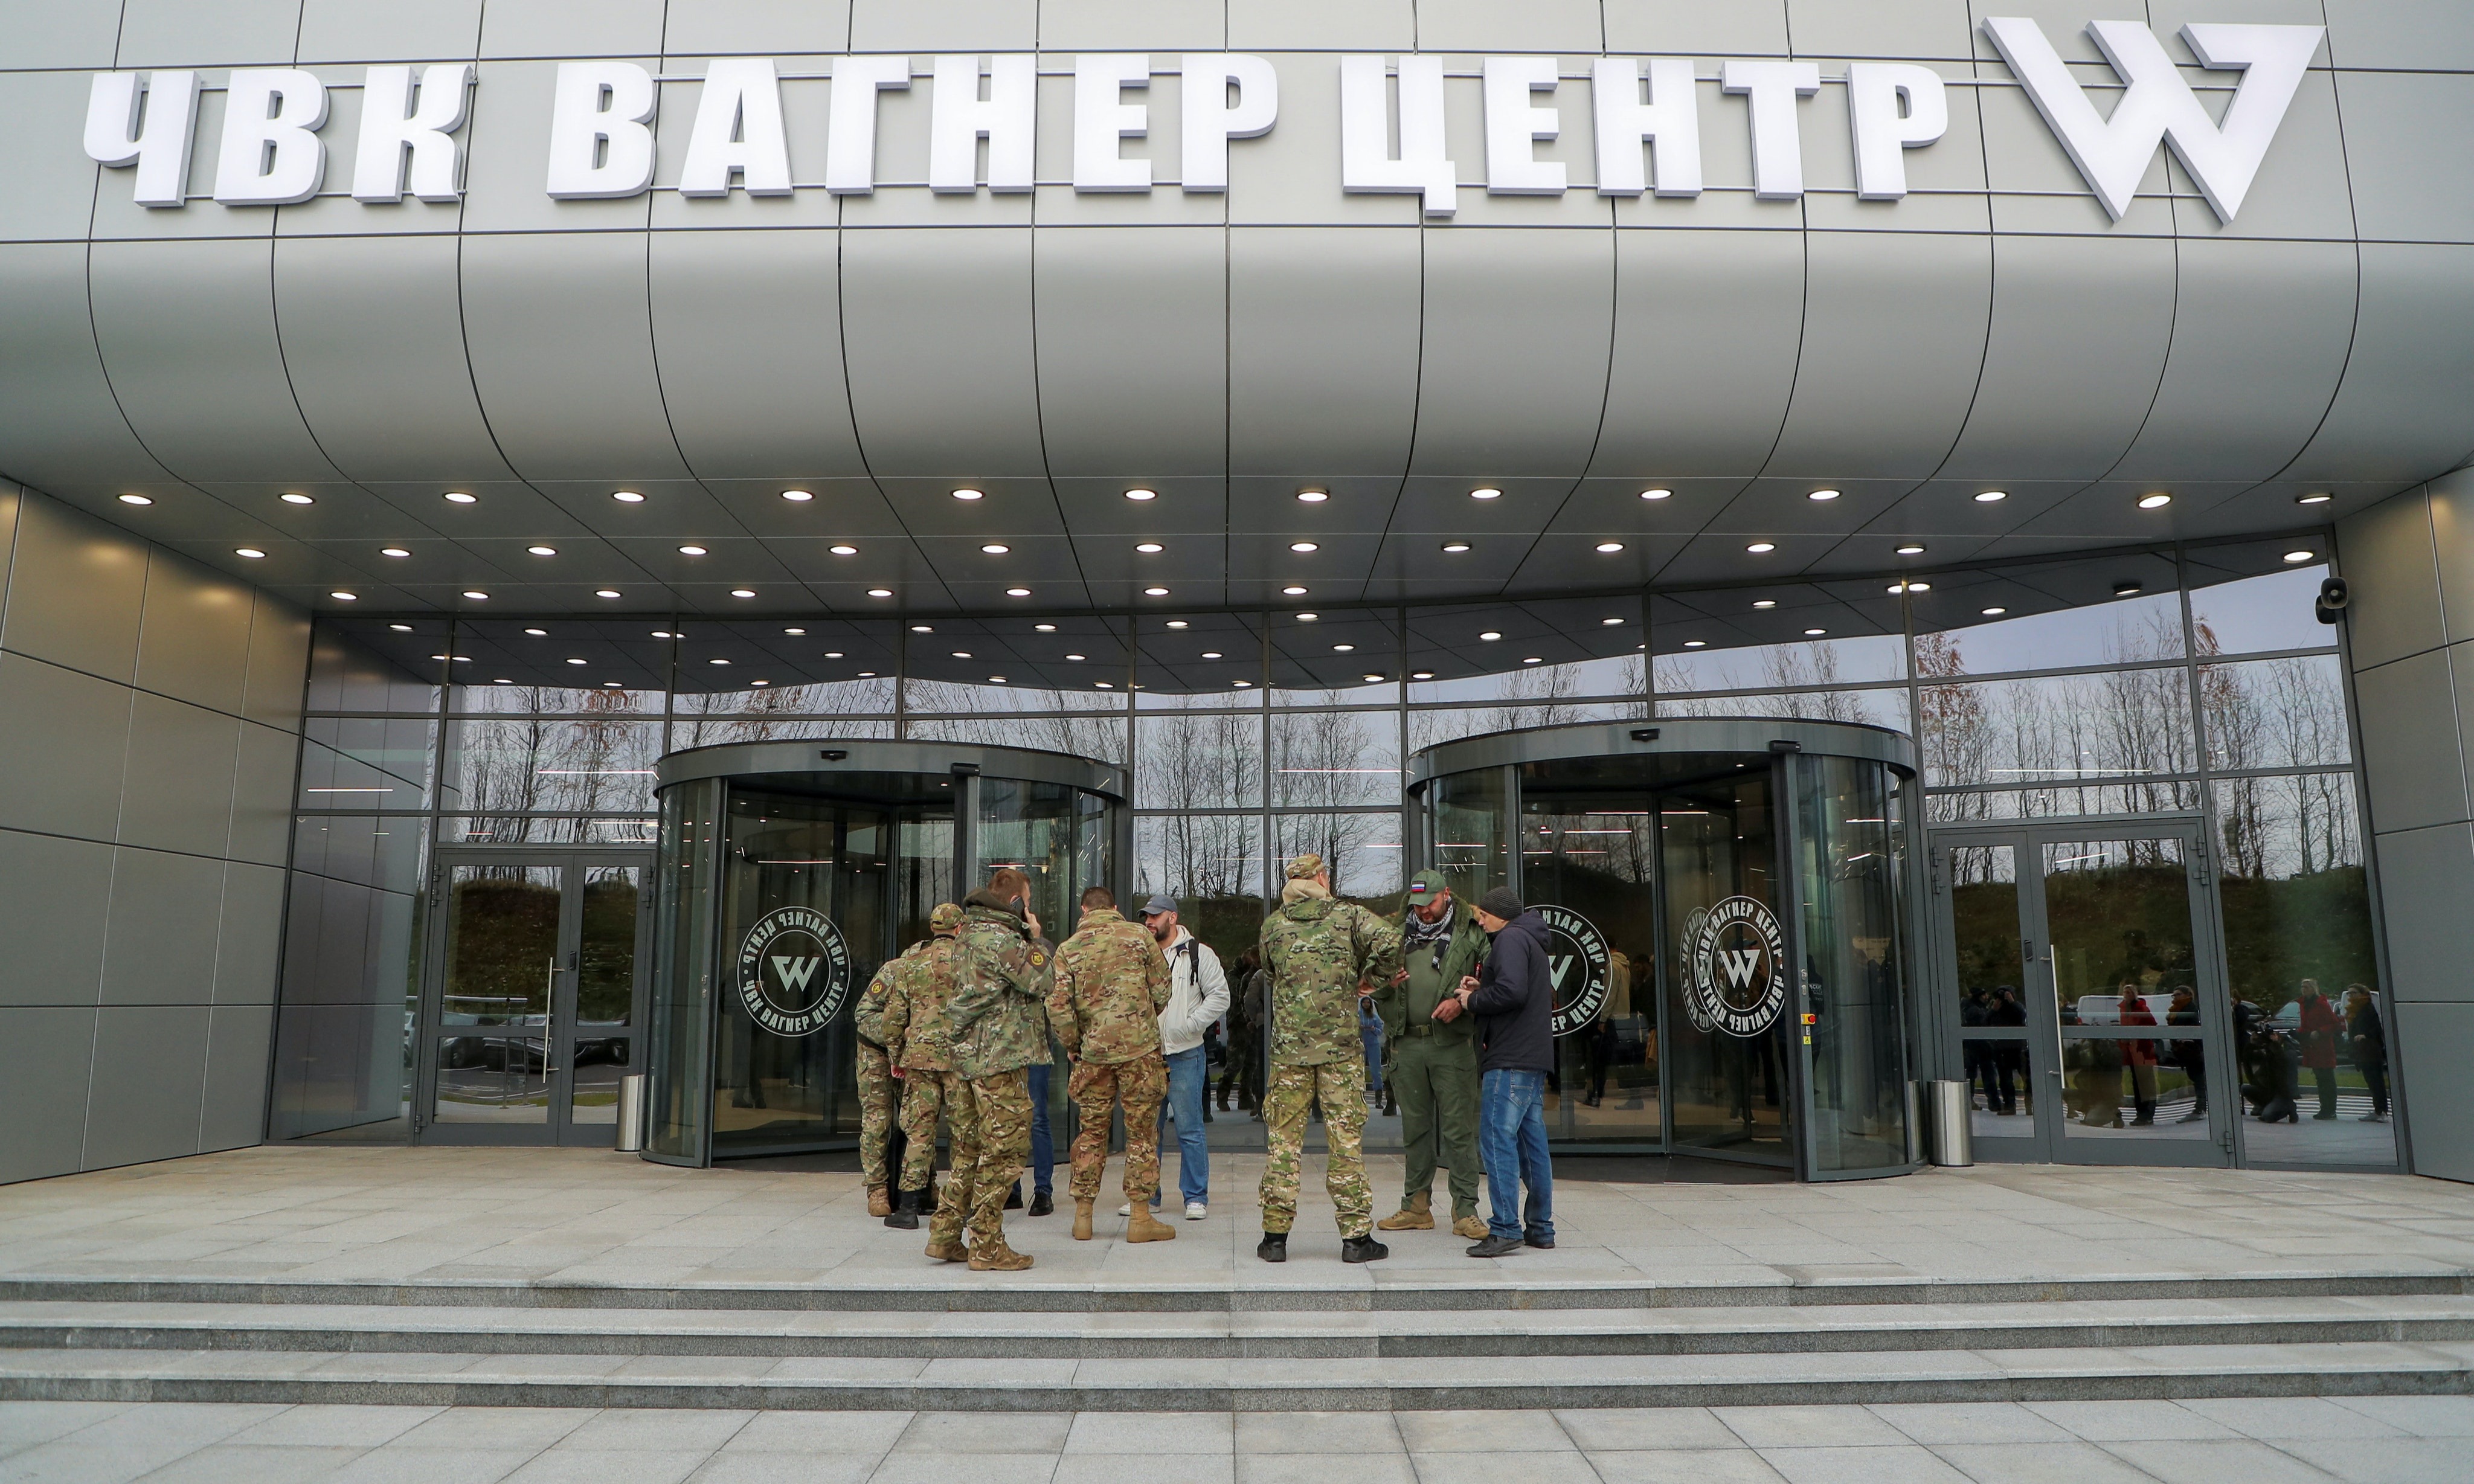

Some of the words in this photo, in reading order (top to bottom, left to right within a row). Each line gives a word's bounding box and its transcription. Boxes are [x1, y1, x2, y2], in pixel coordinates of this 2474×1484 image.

[83, 64, 474, 208] ЧВК
[546, 54, 1279, 200] ВАГНЕР
[1340, 54, 1949, 217] ЦЕНТР
[1981, 16, 2327, 226] W
[1698, 926, 1715, 960] ЧВК
[1711, 901, 1754, 929] ВАГНЕР
[1755, 908, 1783, 958] ЦЕНТР
[1719, 949, 1761, 989] W
[743, 979, 764, 1013] ЧВК
[760, 1007, 810, 1032] ВАГНЕР
[812, 981, 844, 1025] ЦЕНТР
[1569, 979, 1605, 1024] ЦЕНТР
